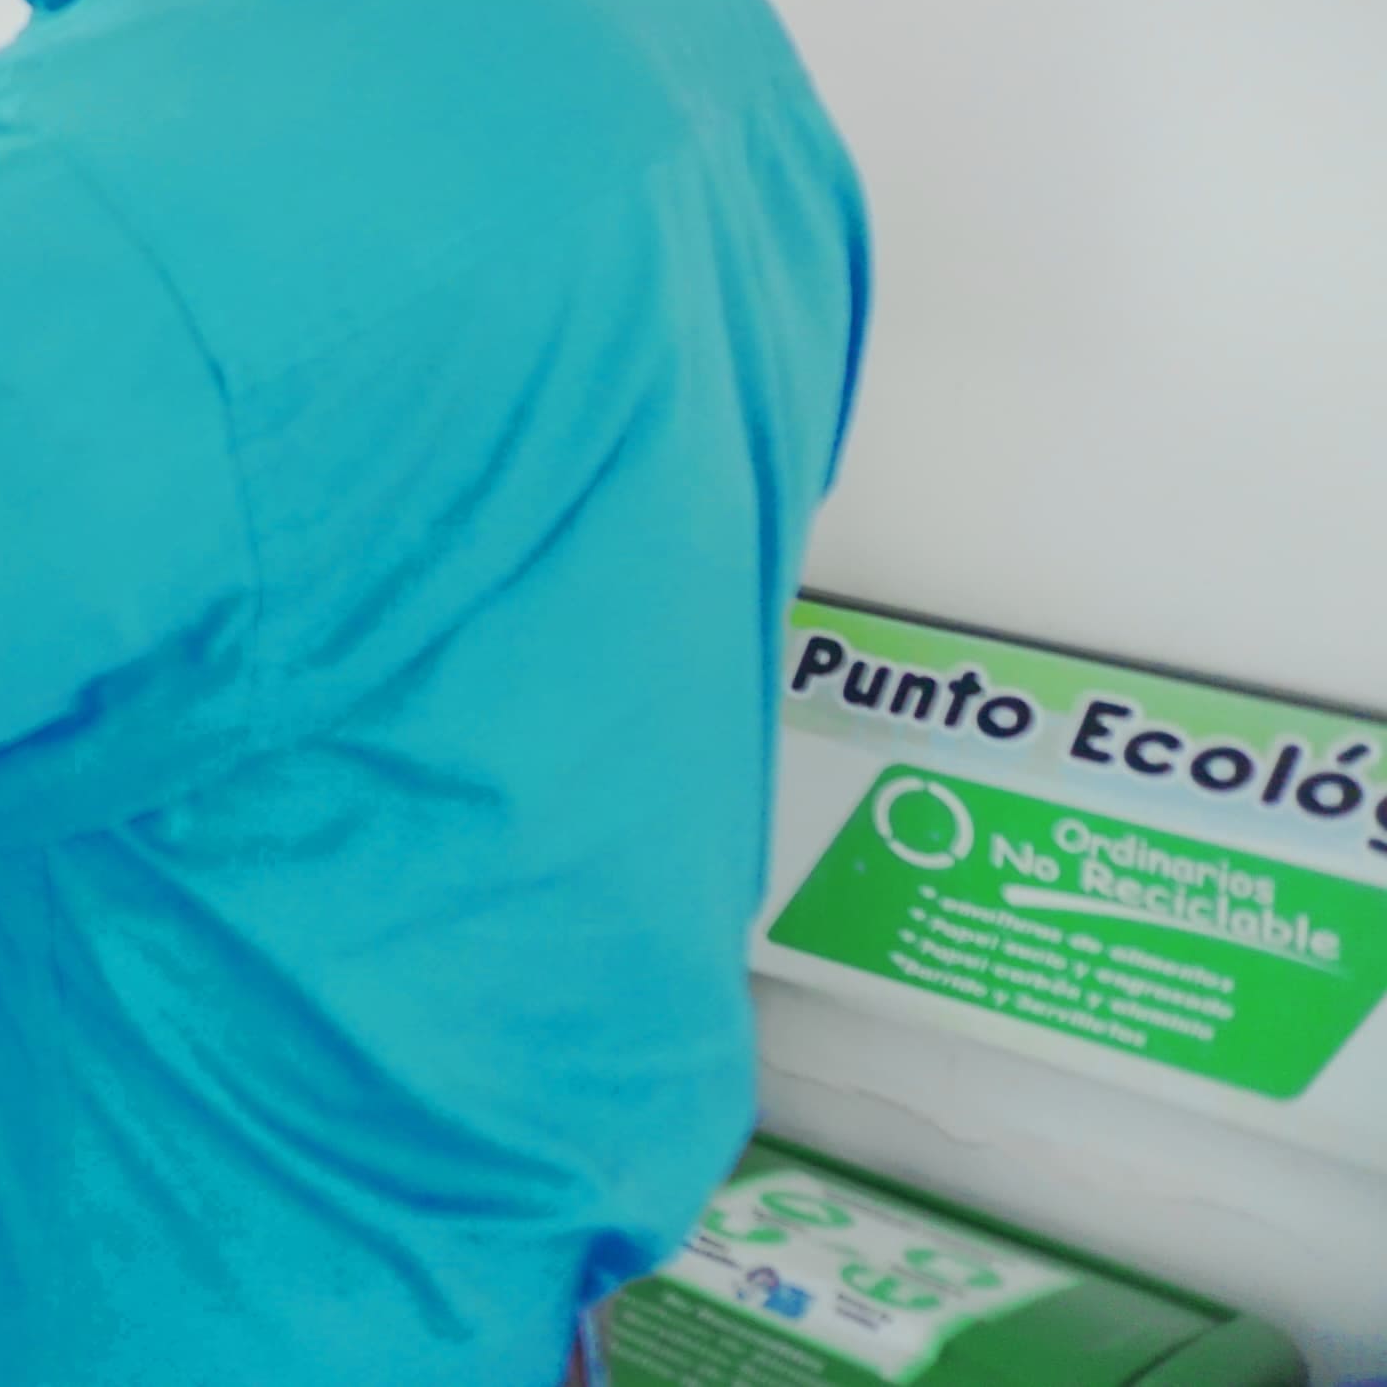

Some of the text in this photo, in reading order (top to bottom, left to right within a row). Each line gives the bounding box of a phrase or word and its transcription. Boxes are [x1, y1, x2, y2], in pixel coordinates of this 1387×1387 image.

[791, 636, 1034, 740] Punto
[990, 832, 1341, 961] No Reciclable
[1051, 817, 1276, 905] Ordinarios
[1108, 944, 1235, 993] alimentos
